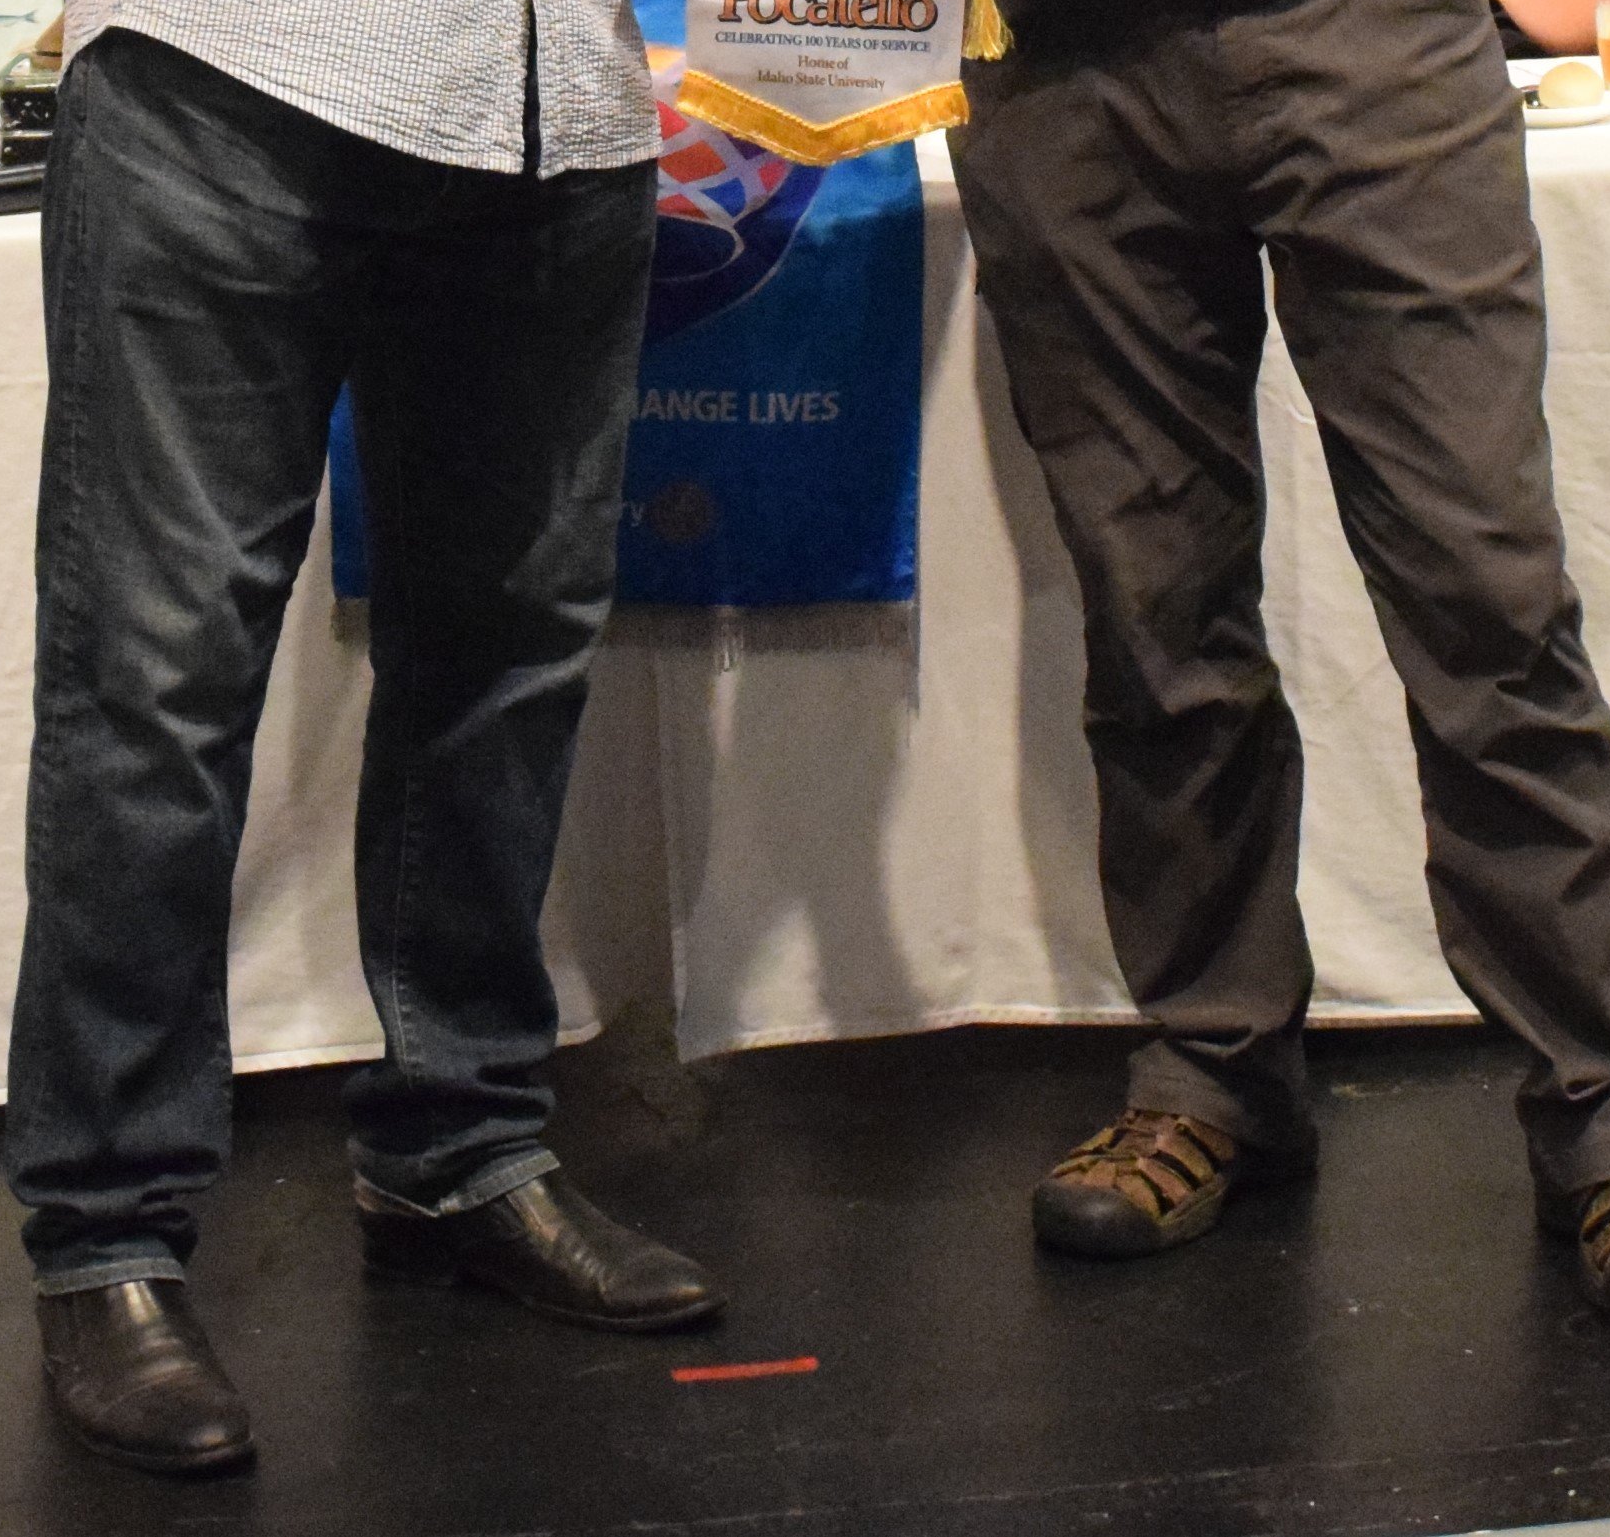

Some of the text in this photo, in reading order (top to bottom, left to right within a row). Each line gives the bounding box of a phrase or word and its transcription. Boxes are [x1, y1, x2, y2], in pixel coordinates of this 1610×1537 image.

[715, 31, 931, 53] CELEBRATING 100 YEARS OF SERVICE
[797, 55, 851, 70] Home of
[757, 70, 886, 90] Idaho State University
[747, 390, 840, 425] LIVES
